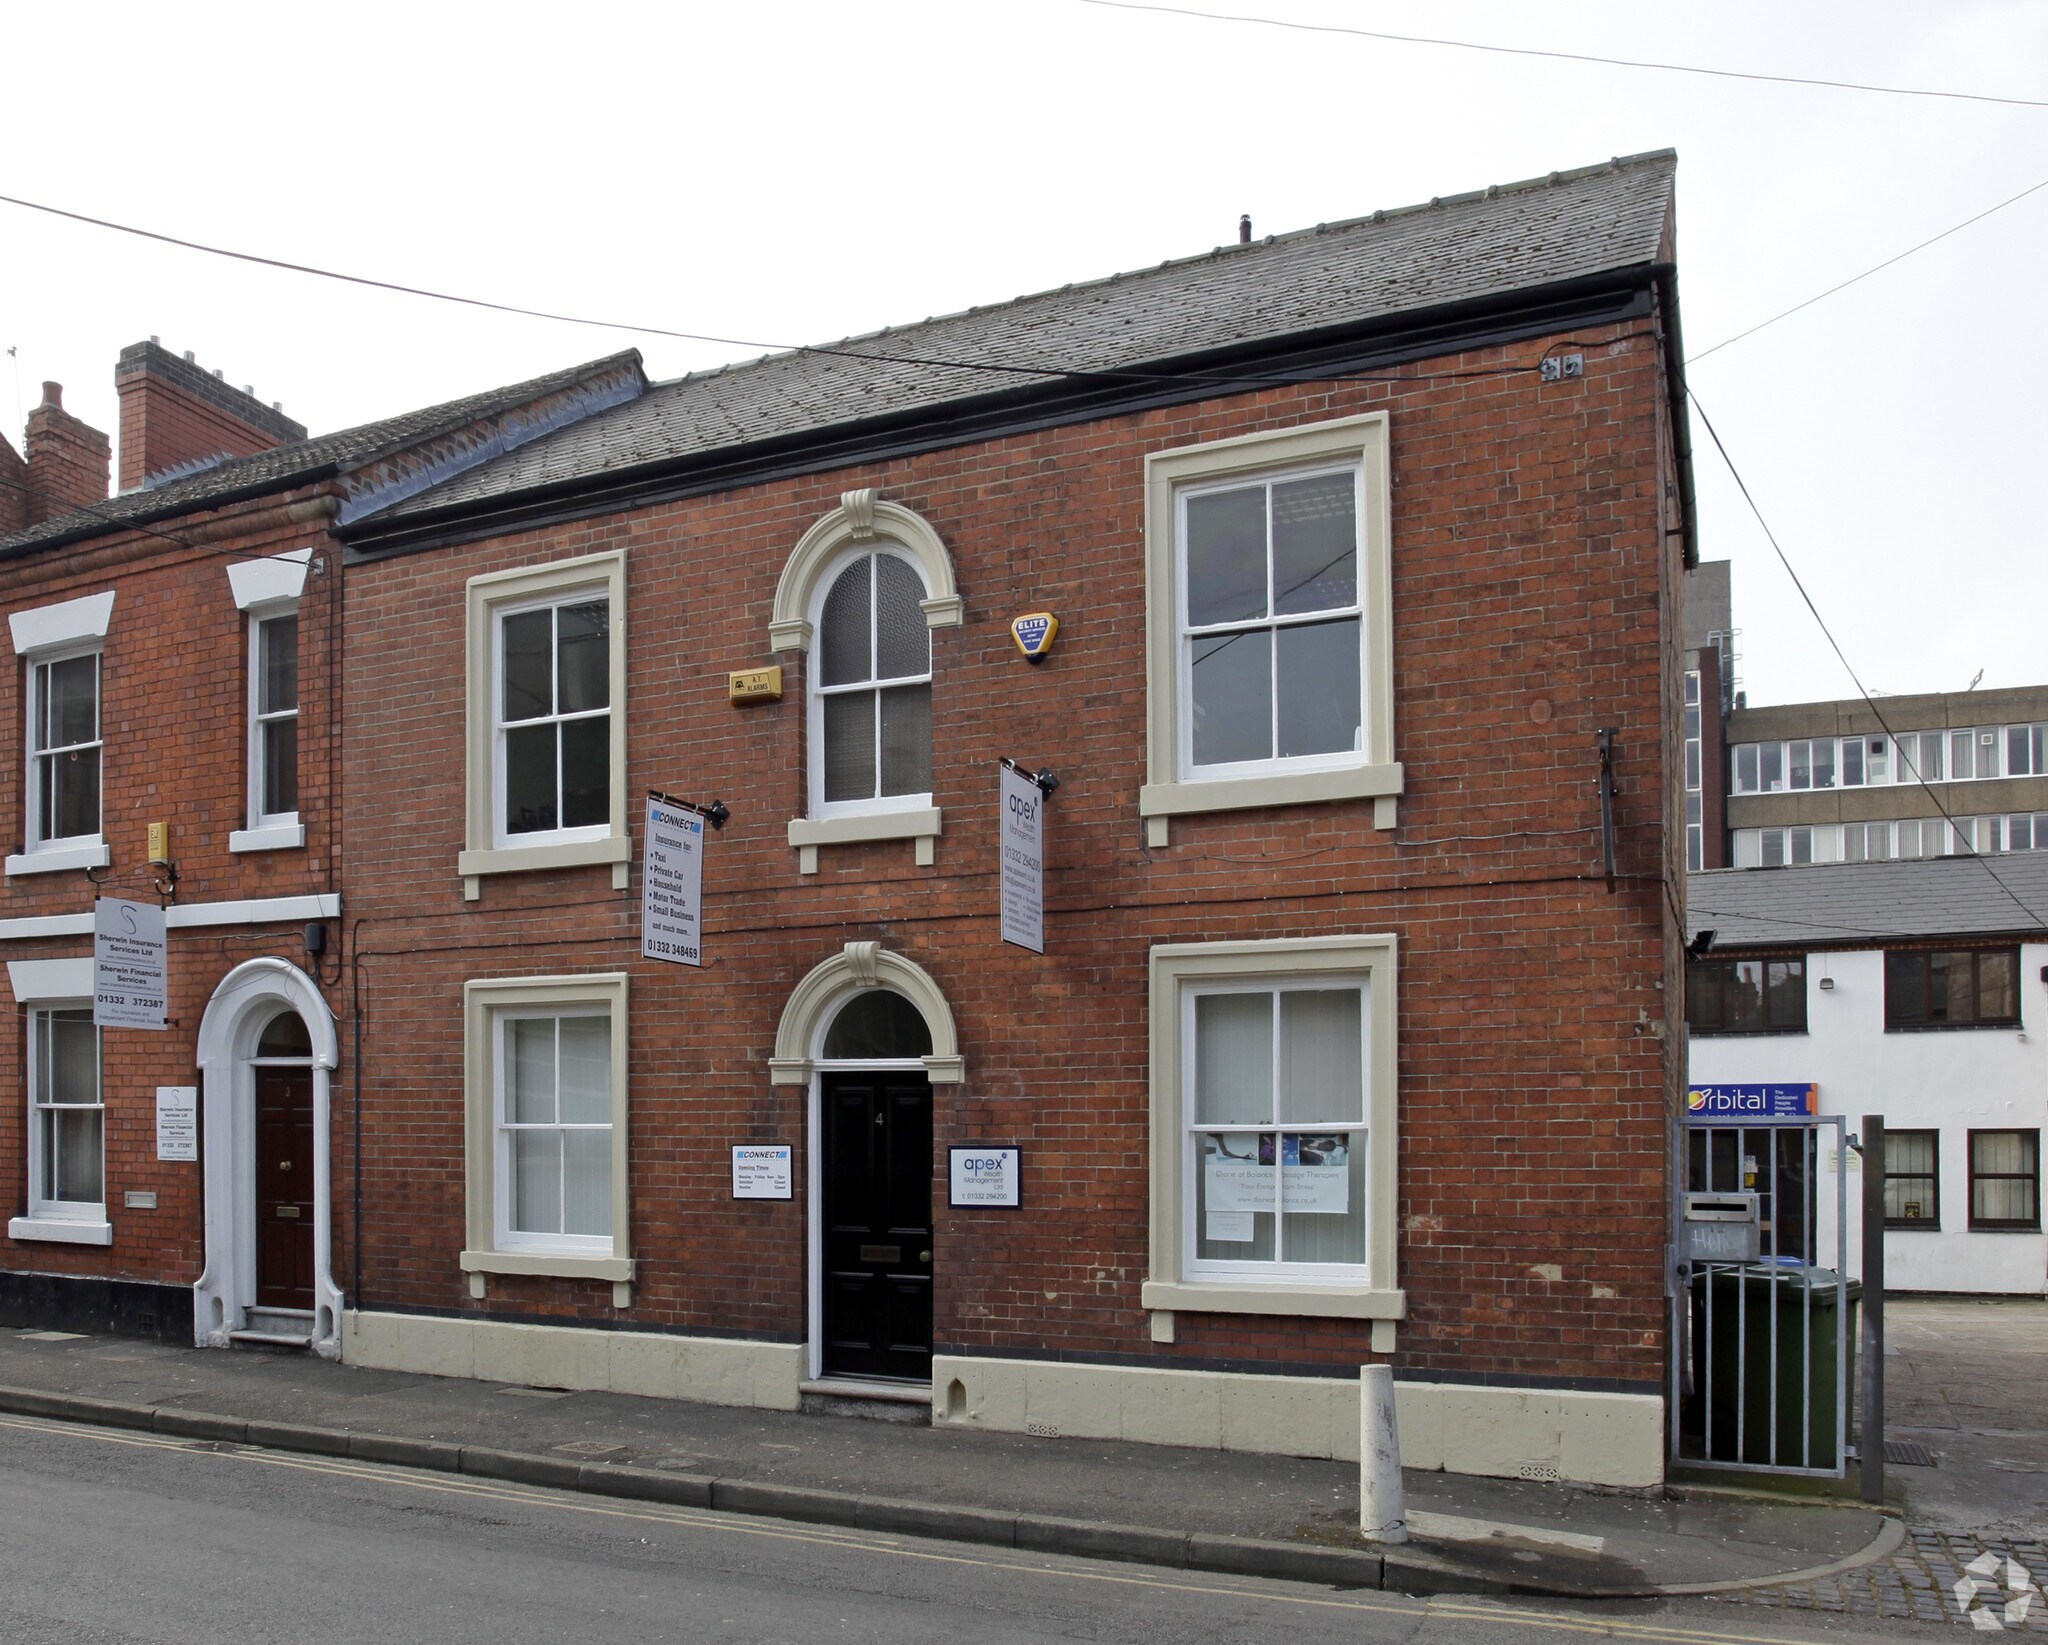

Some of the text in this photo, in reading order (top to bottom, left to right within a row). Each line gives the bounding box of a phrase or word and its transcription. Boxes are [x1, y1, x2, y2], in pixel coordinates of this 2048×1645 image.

[1018, 619, 1045, 629] ELITE
[747, 683, 768, 691] ALARMS
[1009, 794, 1035, 825] apex
[658, 812, 694, 831] CONNECT
[655, 833, 682, 849] Insurance
[654, 851, 666, 862] Taxi
[1005, 845, 1021, 863] 01332
[653, 865, 684, 880] Private Car
[653, 878, 682, 893] Household
[653, 891, 686, 907] Motor Trade
[653, 904, 694, 922] Small Business
[652, 922, 661, 930] and
[662, 924, 675, 933] much
[99, 934, 163, 949] Sherwin Insurance
[110, 944, 153, 956] Services Ltd
[648, 939, 697, 959] 01332 348469
[100, 964, 162, 978] Sherwin Financial
[117, 975, 147, 985] Services
[98, 994, 163, 1008] 01332 372387
[875, 1112, 884, 1126] 4
[964, 1158, 1003, 1176] apex
[1306, 1171, 1339, 1179] Therapies
[1256, 1183, 1275, 1191] Escap
